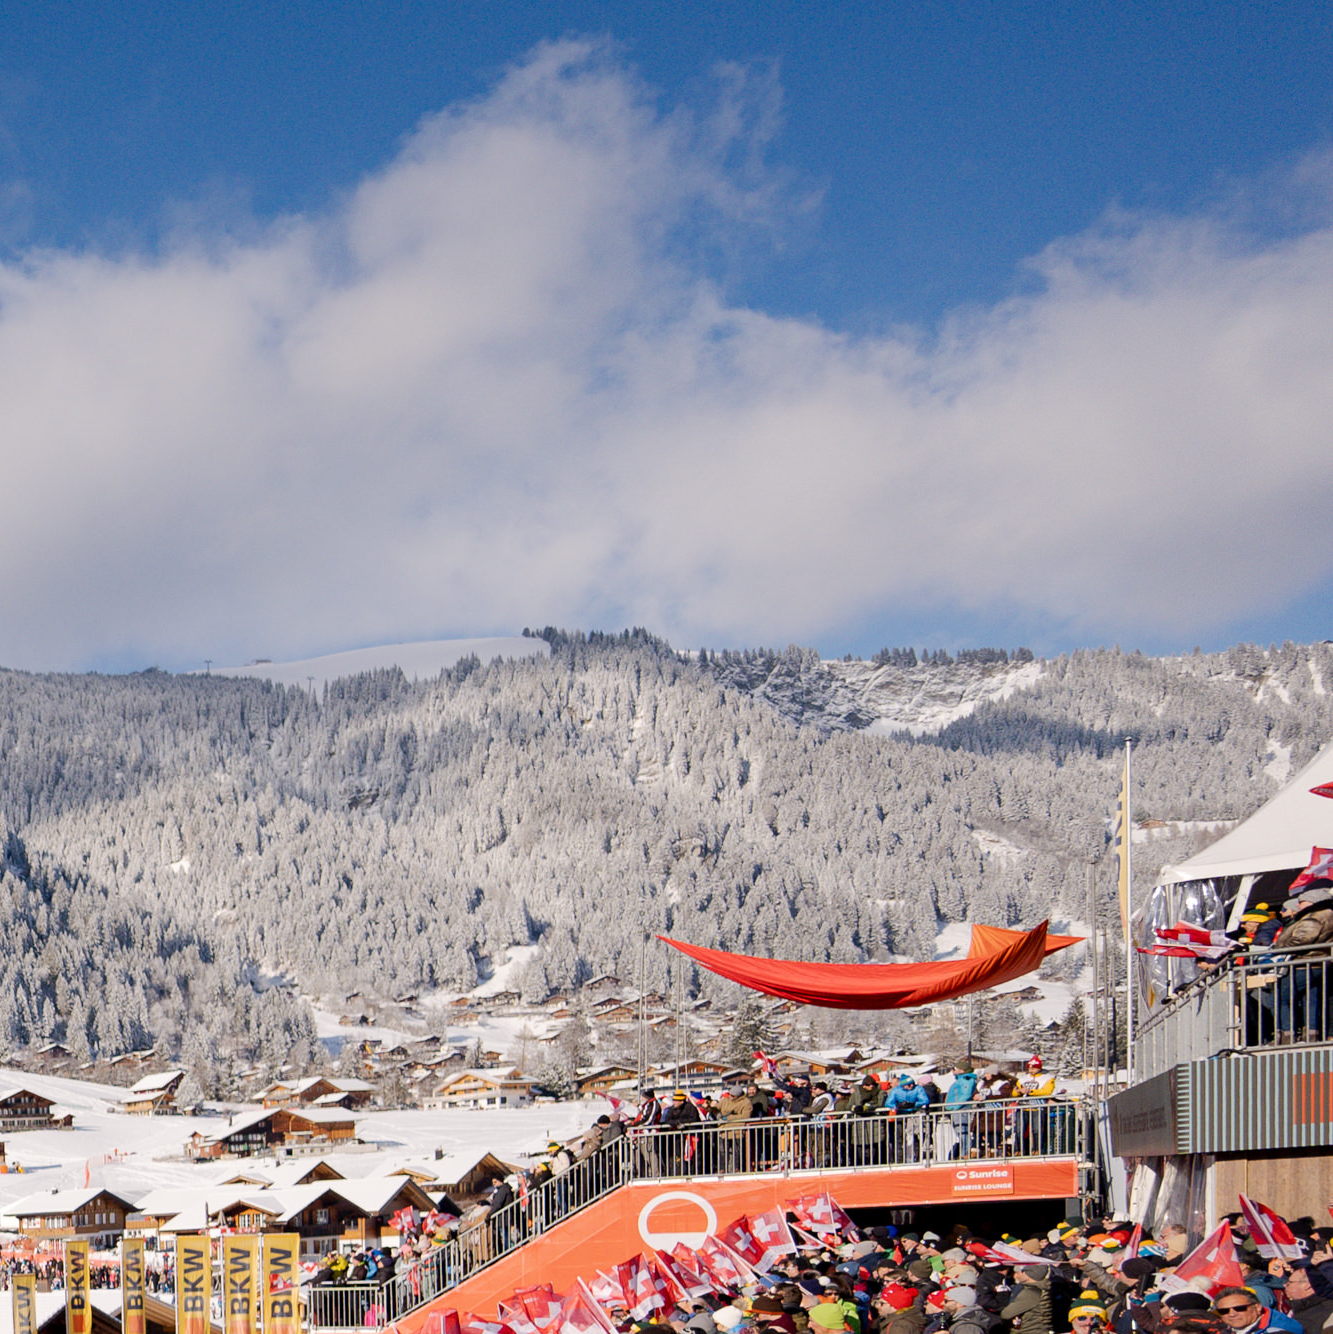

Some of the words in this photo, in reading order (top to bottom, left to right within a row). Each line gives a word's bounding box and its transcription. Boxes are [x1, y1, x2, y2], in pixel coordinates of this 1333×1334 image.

[969, 1169, 1008, 1179] Sunrise
[70, 1250, 86, 1309] BKW
[127, 1248, 143, 1310] BKW
[184, 1248, 204, 1312] BKW
[230, 1247, 250, 1315] BKW
